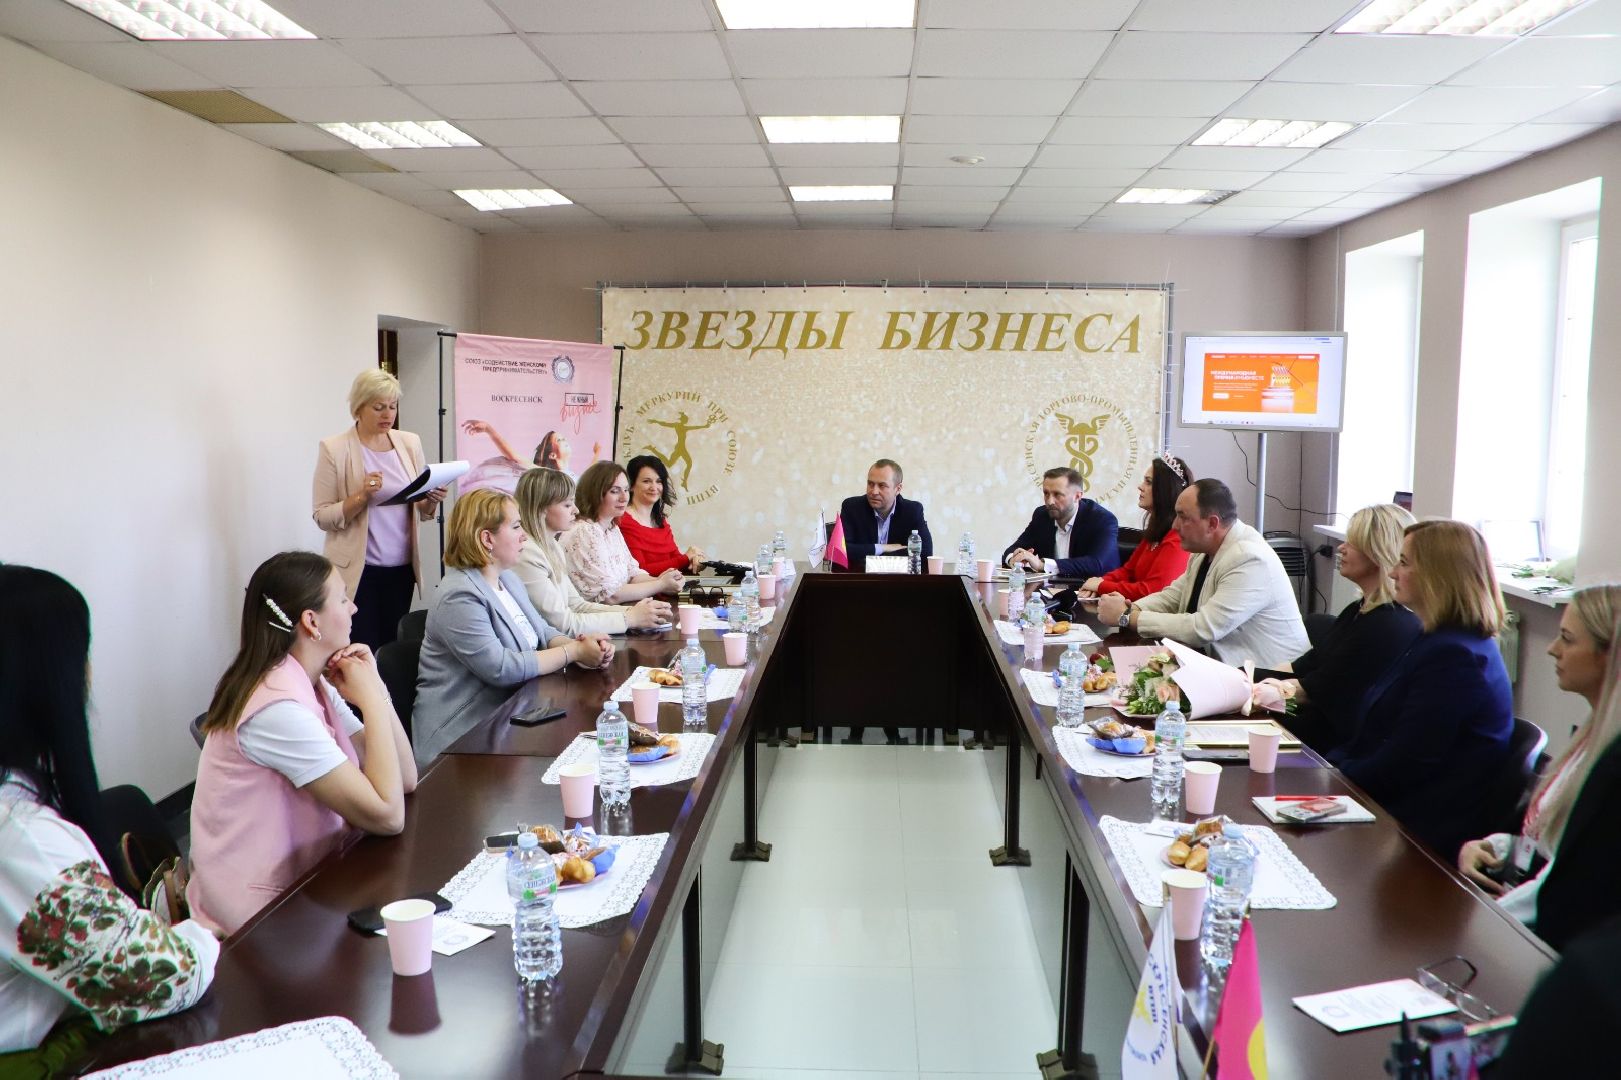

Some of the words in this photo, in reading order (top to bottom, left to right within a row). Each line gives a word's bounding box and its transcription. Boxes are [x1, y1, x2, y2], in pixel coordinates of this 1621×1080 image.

[623, 310, 855, 360] ЗВЕЗДЫ
[877, 311, 1140, 353] БИЗНЕСА
[491, 394, 543, 404] ВОСКРЕСЕНСК
[622, 425, 635, 459] КЛУБ
[635, 391, 702, 417] МЕРКУРИЙ
[707, 401, 729, 423] ПРИ
[723, 430, 737, 476] СОЮЗЕ
